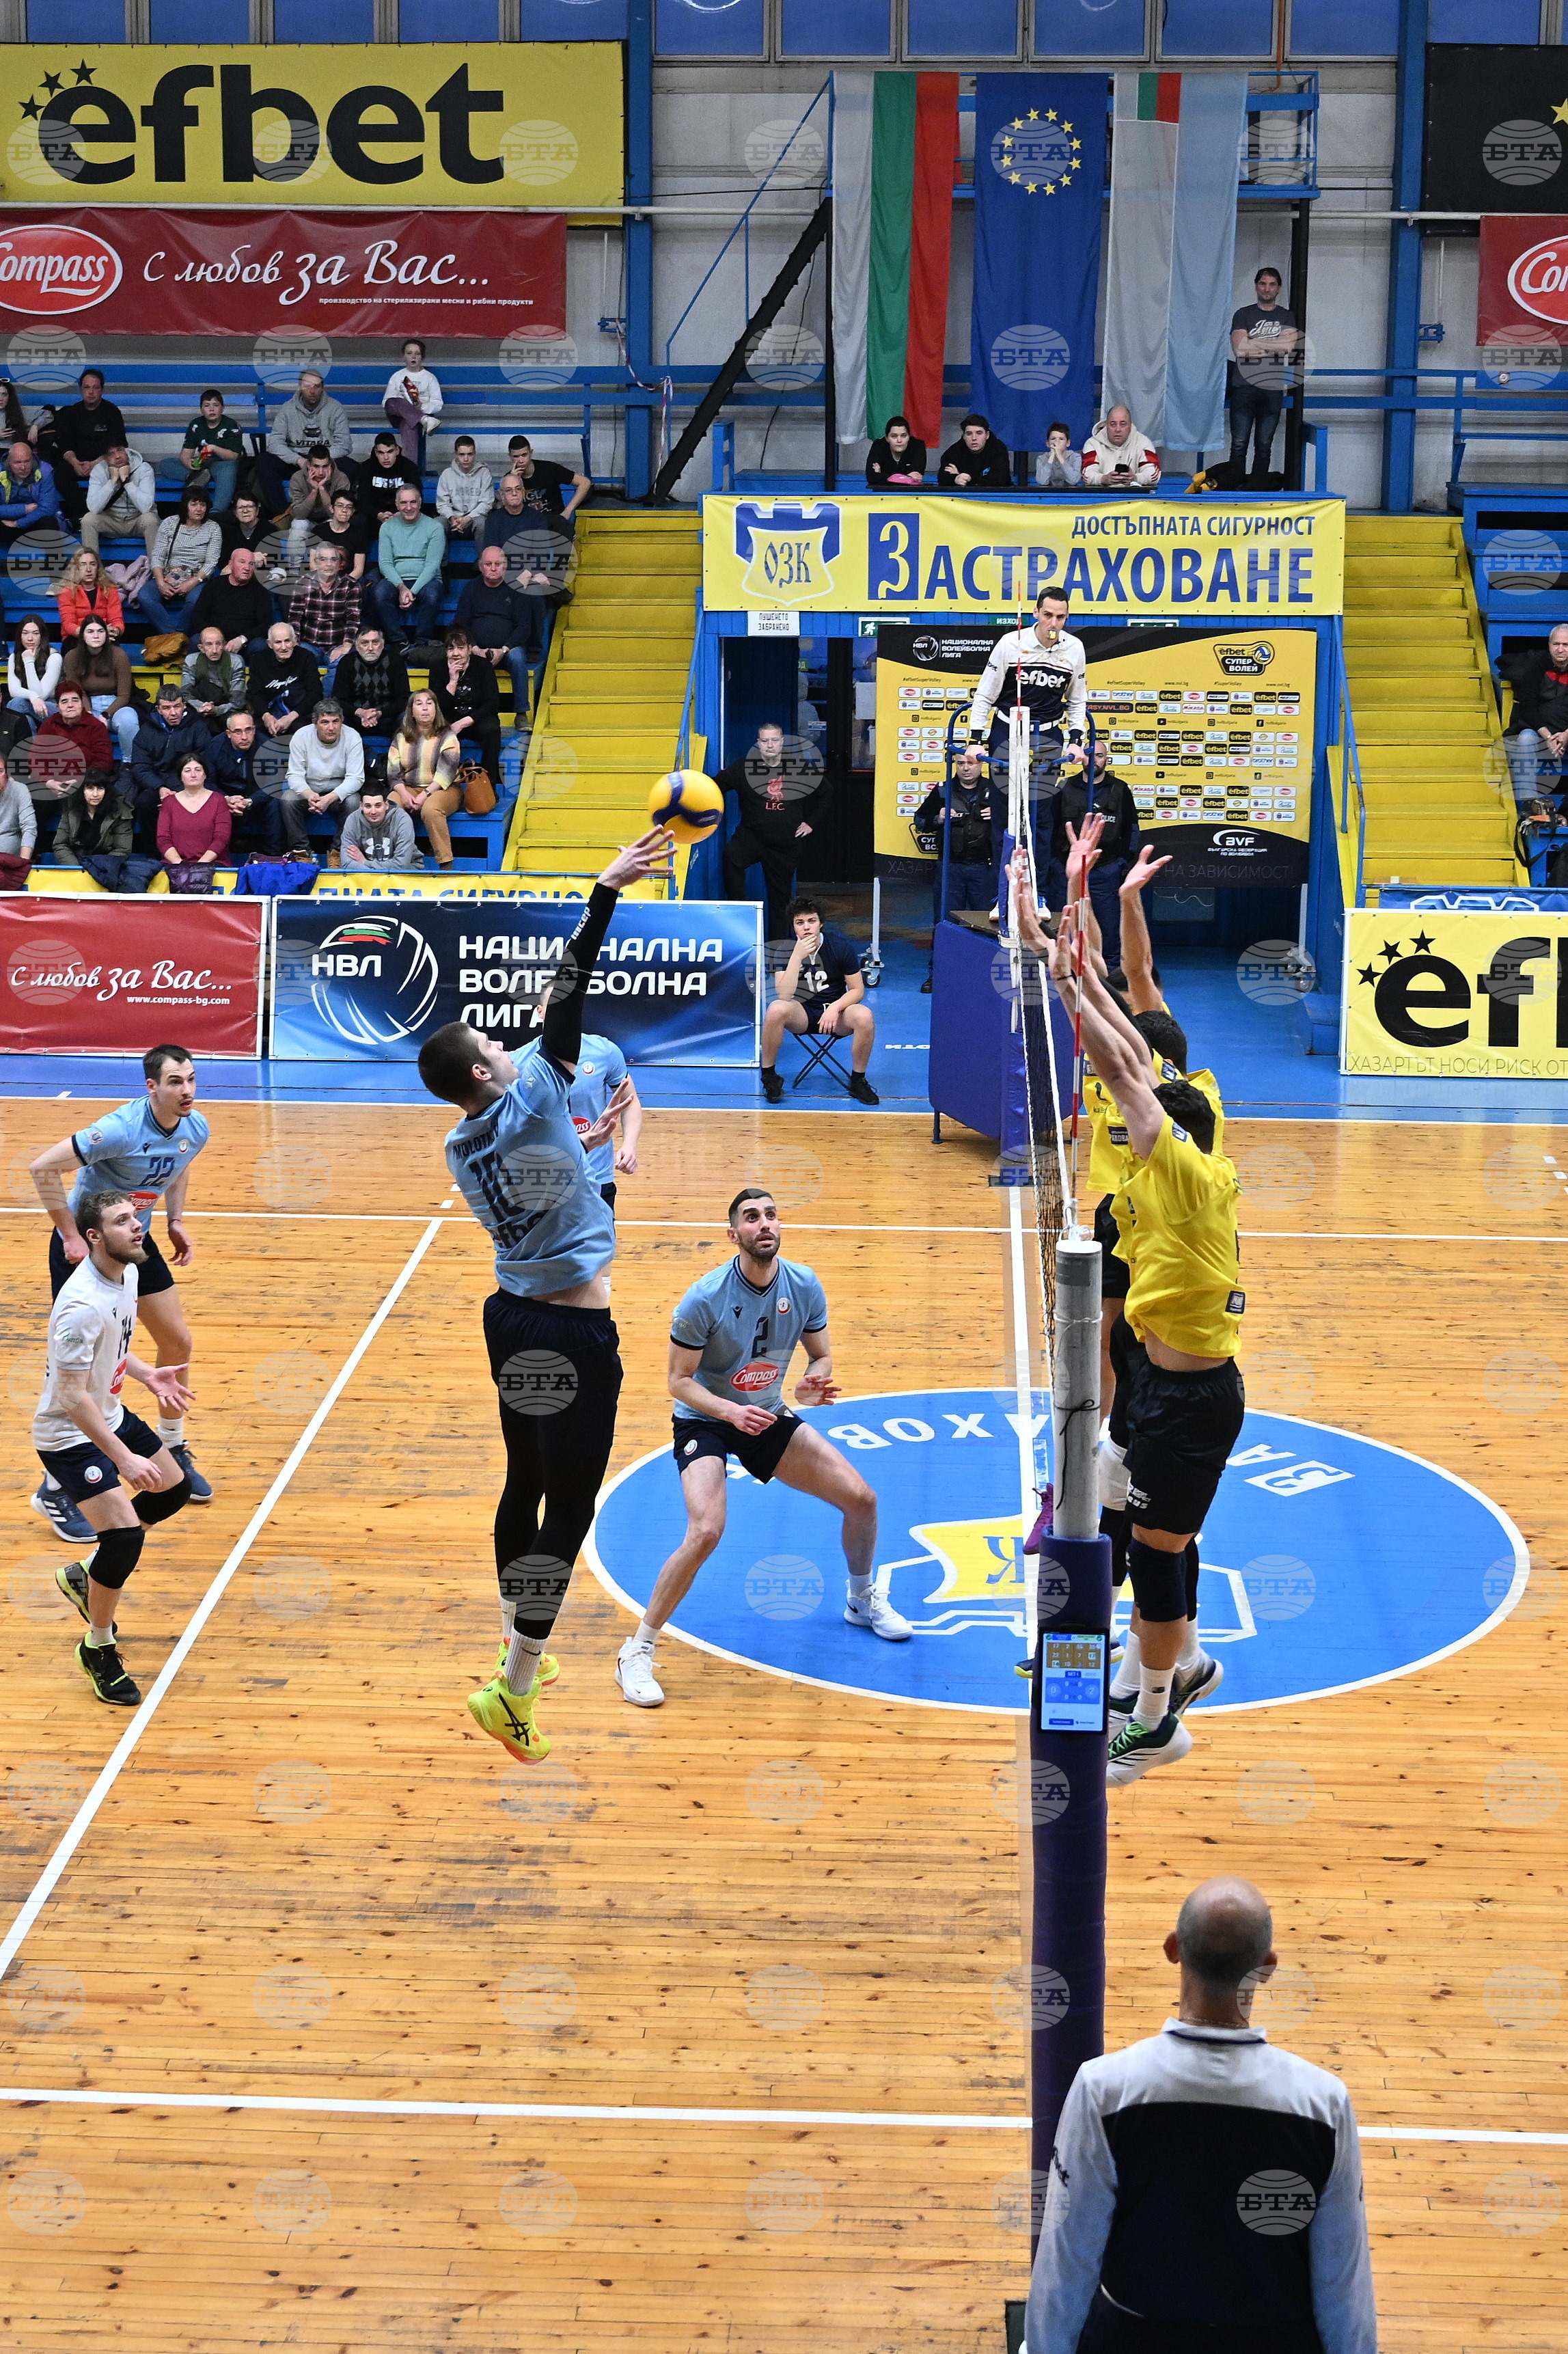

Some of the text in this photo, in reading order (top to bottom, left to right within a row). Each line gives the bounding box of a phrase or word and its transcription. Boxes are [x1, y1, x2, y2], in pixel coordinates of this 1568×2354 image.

[38, 63, 504, 184] efbet
[174, 244, 284, 284] любов
[279, 253, 351, 306] за
[363, 240, 489, 286] Вас...
[1071, 516, 1315, 538] ДОСТЪПНАТА СИГУРНОСТ
[877, 521, 1313, 603] ЗАСТРАХОВАНЕ
[758, 622, 790, 631] ЗАБРАНЕНО
[1016, 669, 1066, 688] efbet
[1226, 837, 1254, 846] BVF
[888, 861, 934, 874] ХАЗАР
[459, 935, 723, 963] НАЦИНАЛНА
[312, 954, 382, 977] НВЛ
[30, 961, 102, 988] любов
[96, 966, 144, 1001] за
[151, 959, 232, 990] Вас...
[459, 969, 707, 996] ВОЛЕБОЛНА
[803, 970, 829, 992] 12
[126, 996, 230, 1007] www.compass-bg.com
[1350, 1056, 1435, 1073] ХАЗАРТЪТ
[1440, 1058, 1490, 1074] НОСИ
[1496, 1059, 1541, 1076] РИСК
[139, 1157, 174, 1186] 22
[118, 1315, 132, 1360] 14
[751, 1316, 769, 1358] 2
[732, 1367, 778, 1386] Compass
